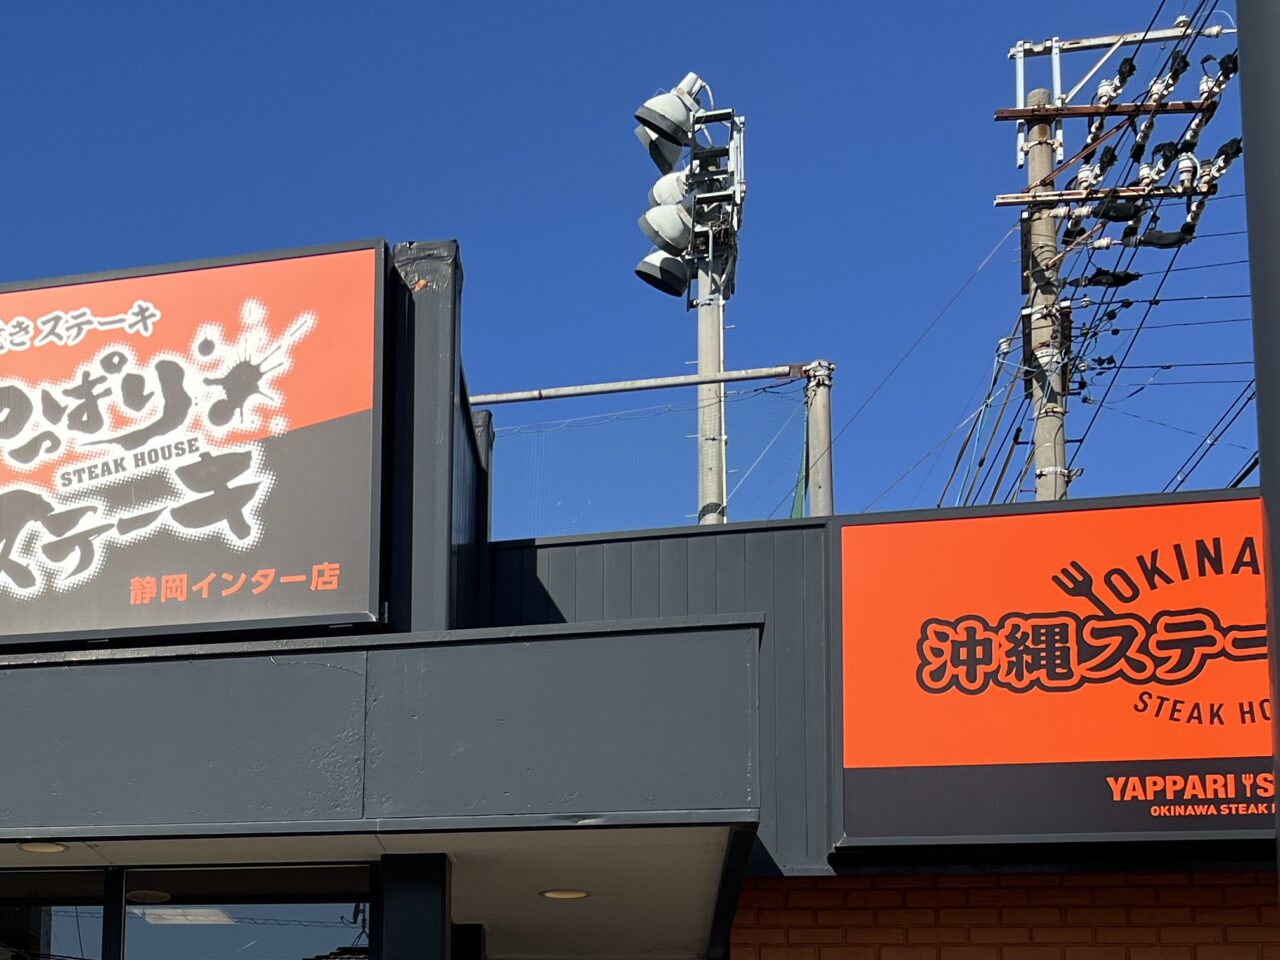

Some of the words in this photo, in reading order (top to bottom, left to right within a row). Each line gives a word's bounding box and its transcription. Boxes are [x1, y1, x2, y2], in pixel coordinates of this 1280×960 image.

[60, 456, 126, 488] STEAK
[133, 437, 200, 468] HOUSE
[129, 562, 341, 606] 静岡インター店
[1133, 691, 1225, 725] STEAK
[1106, 773, 1236, 801] YAPPARI
[1150, 804, 1218, 817] OKINAWA
[1220, 803, 1269, 815] STEAK
